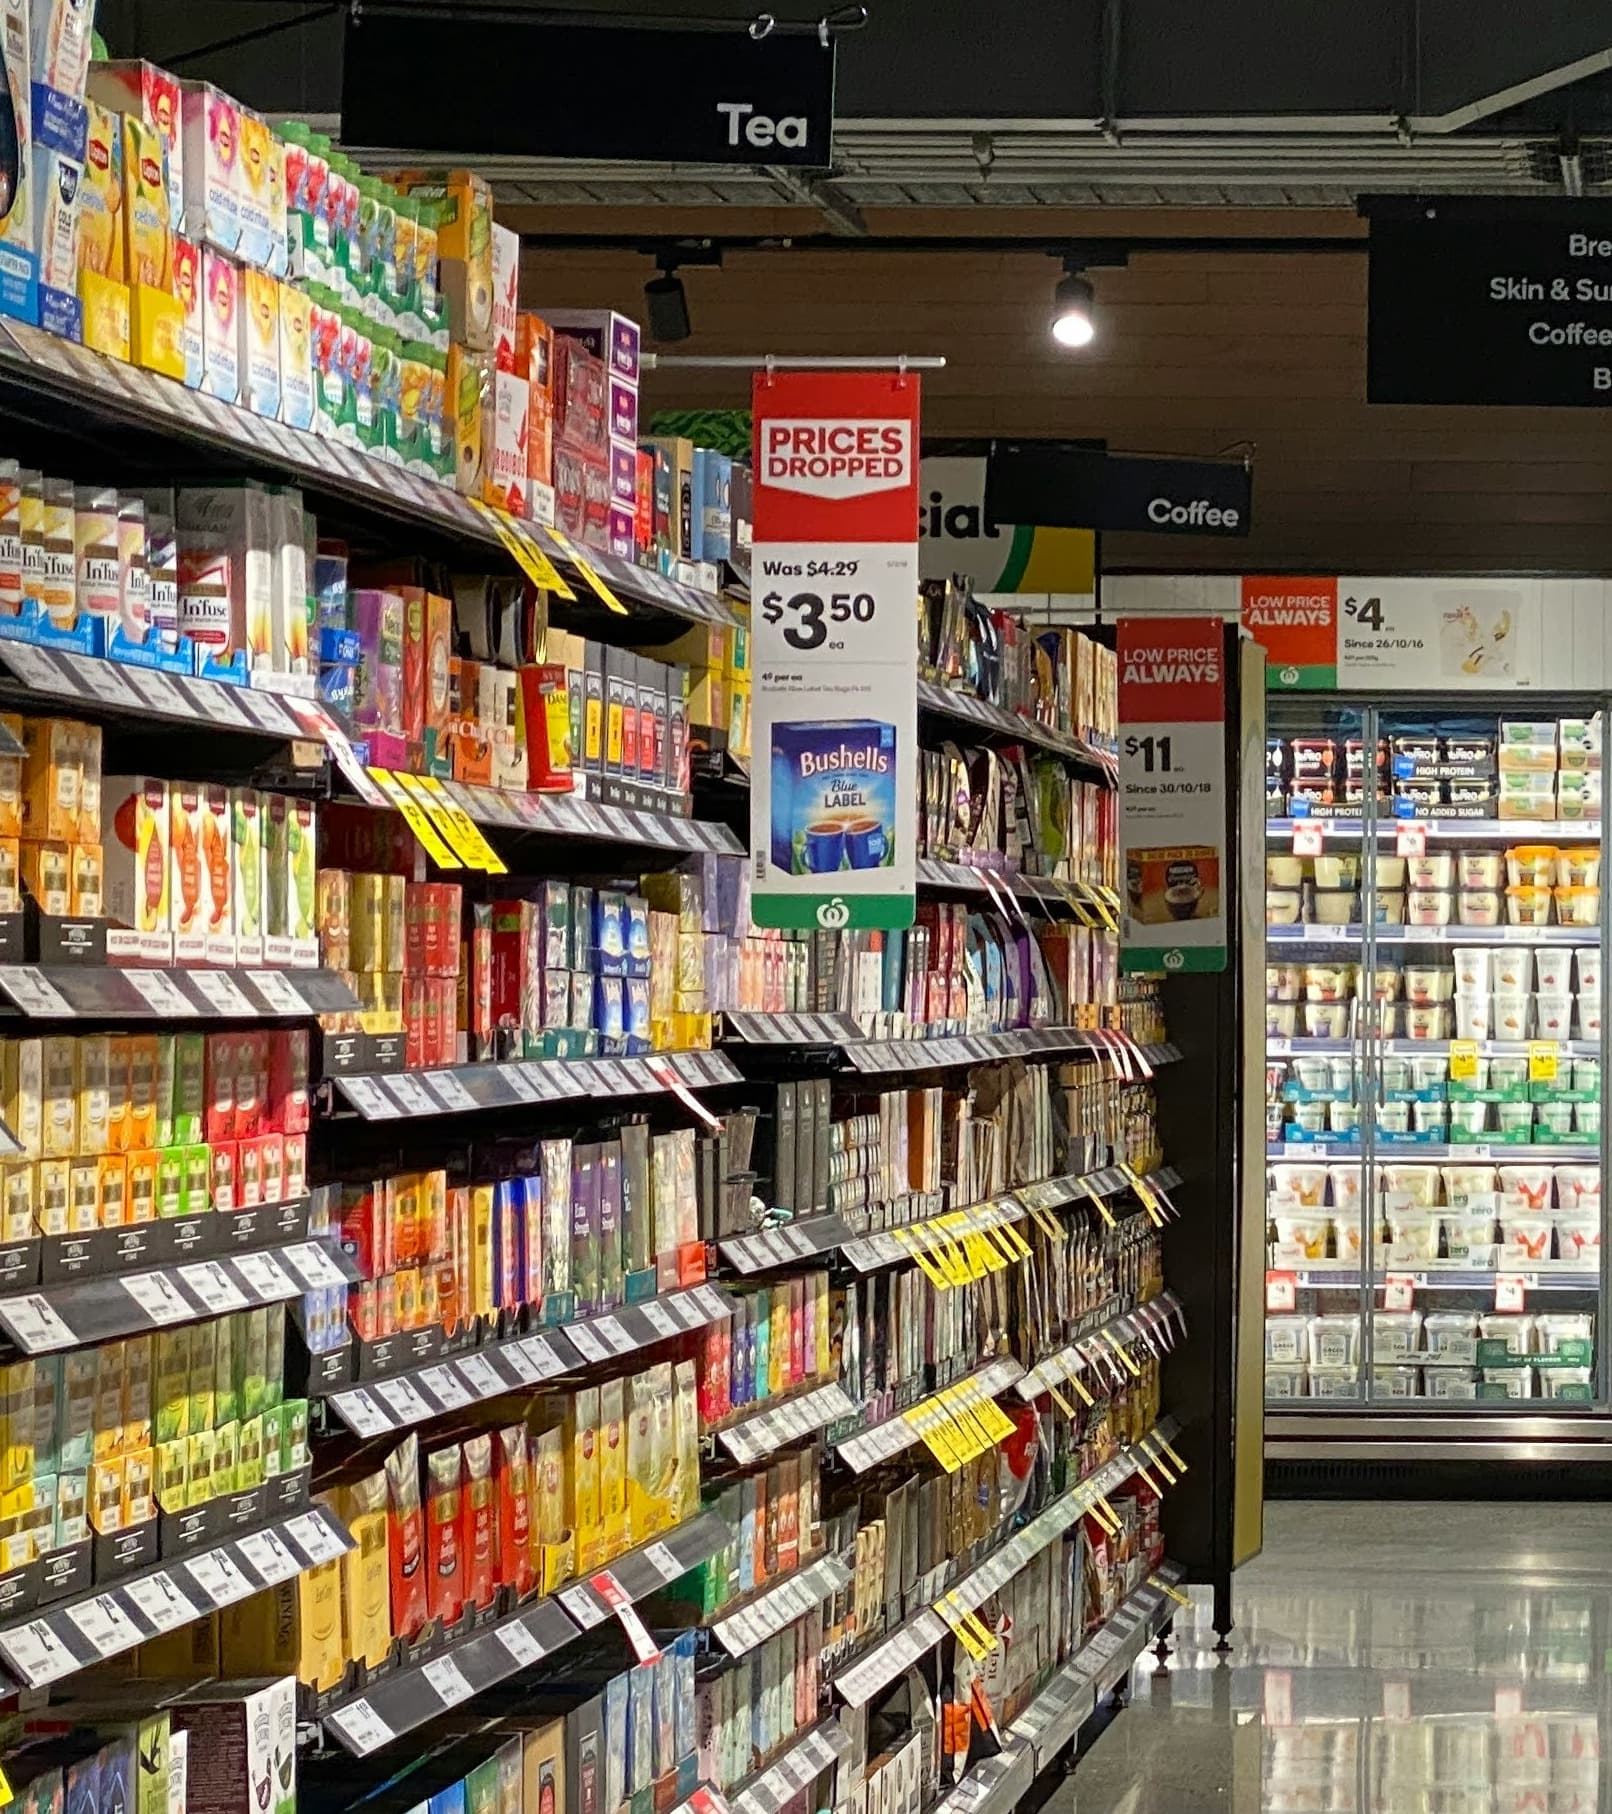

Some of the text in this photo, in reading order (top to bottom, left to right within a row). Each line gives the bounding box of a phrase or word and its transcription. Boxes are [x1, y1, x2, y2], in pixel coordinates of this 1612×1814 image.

[717, 102, 807, 147] Tea
[1489, 277, 1545, 300] Skin
[1550, 278, 1570, 301] &
[768, 426, 903, 455] PRICES
[767, 457, 903, 478] DROPPED
[1147, 497, 1240, 528] Coffee
[762, 560, 860, 578] Was $4.29
[1250, 596, 1331, 609] LOW PRICE
[1248, 609, 1331, 626] ALWAYS
[1344, 596, 1384, 631] $4
[828, 640, 845, 650] ea
[1344, 639, 1424, 650] Since 26/10/16
[1123, 648, 1218, 663] LOW PRICE
[1123, 664, 1220, 684] ALWAYS
[800, 744, 888, 777] Bushells
[1125, 736, 1171, 773] $11
[1416, 767, 1474, 776] HIGH PROTEIN
[831, 778, 858, 793] Blue
[1125, 783, 1211, 795] Since 30/10/18
[824, 792, 866, 808] LABEL
[1311, 807, 1332, 817] HIGH
[1415, 807, 1484, 817] NO ADDED SUGAR
